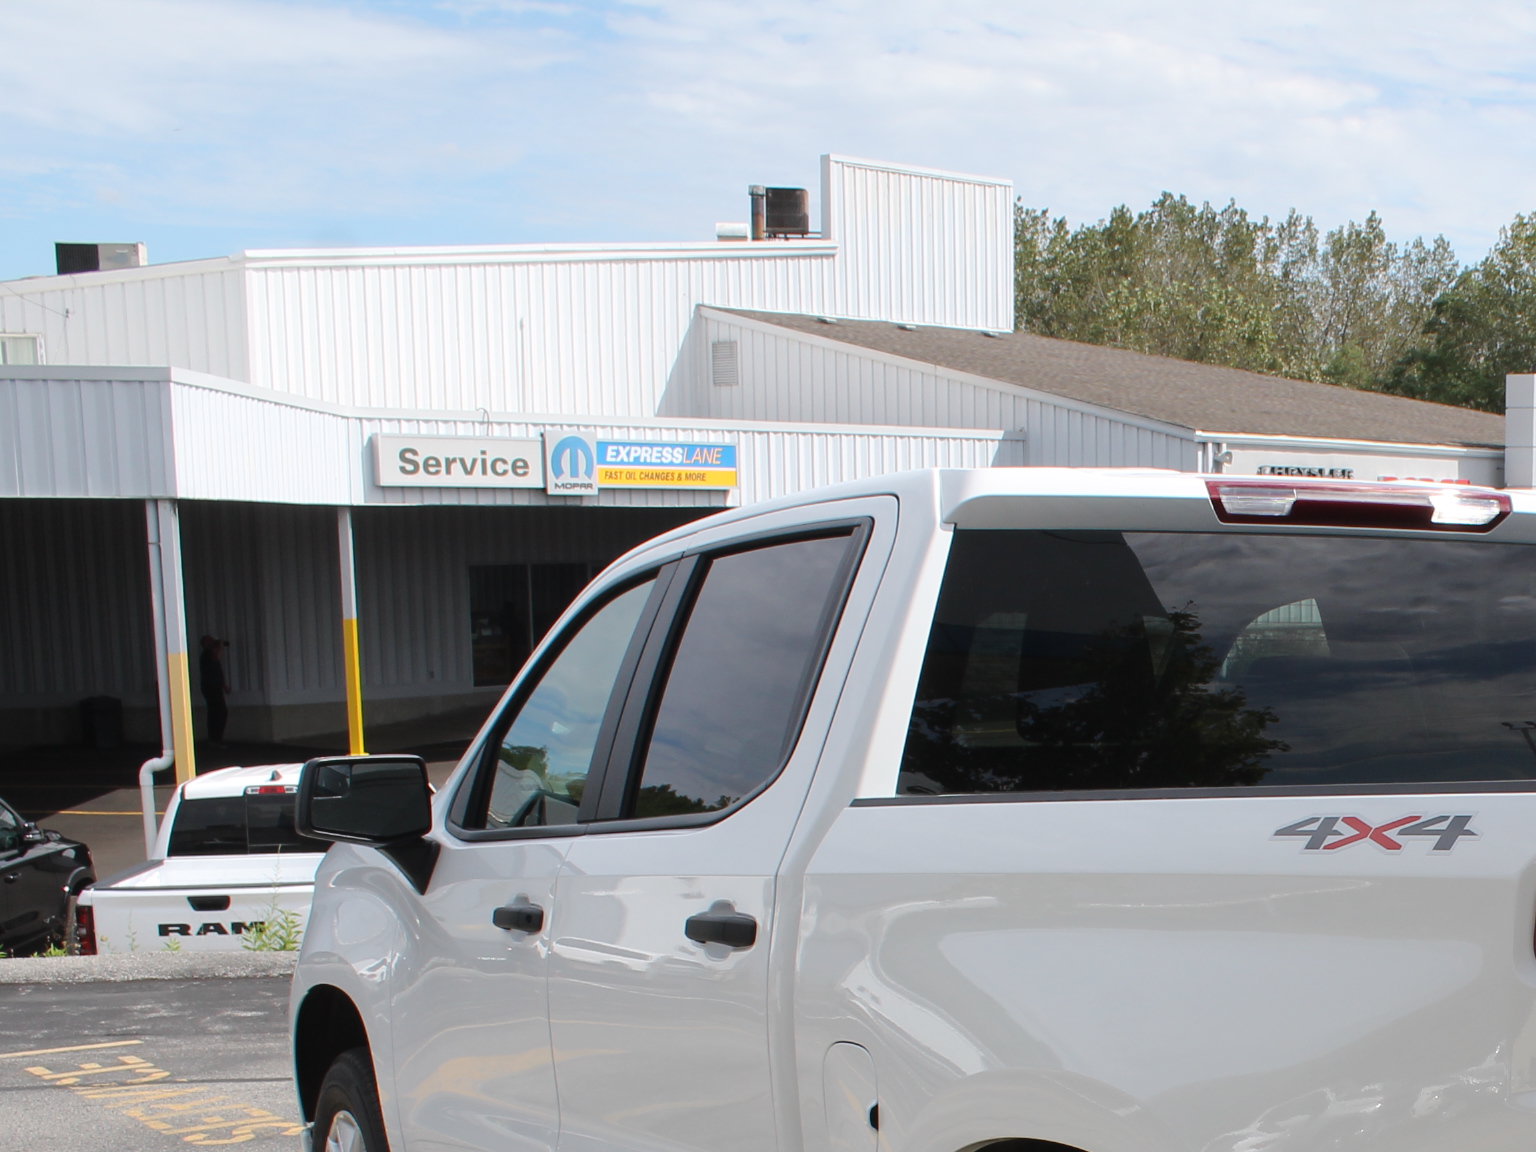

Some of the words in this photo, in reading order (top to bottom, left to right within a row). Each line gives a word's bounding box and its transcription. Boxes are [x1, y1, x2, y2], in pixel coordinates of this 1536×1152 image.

[398, 447, 531, 477] Service
[604, 470, 623, 481] FAST
[625, 471, 637, 481] OIL
[639, 471, 675, 482] CHANGES
[676, 472, 682, 482] &
[684, 472, 707, 482] MORE
[554, 482, 593, 490] MOPAR
[157, 920, 266, 937] RAM
